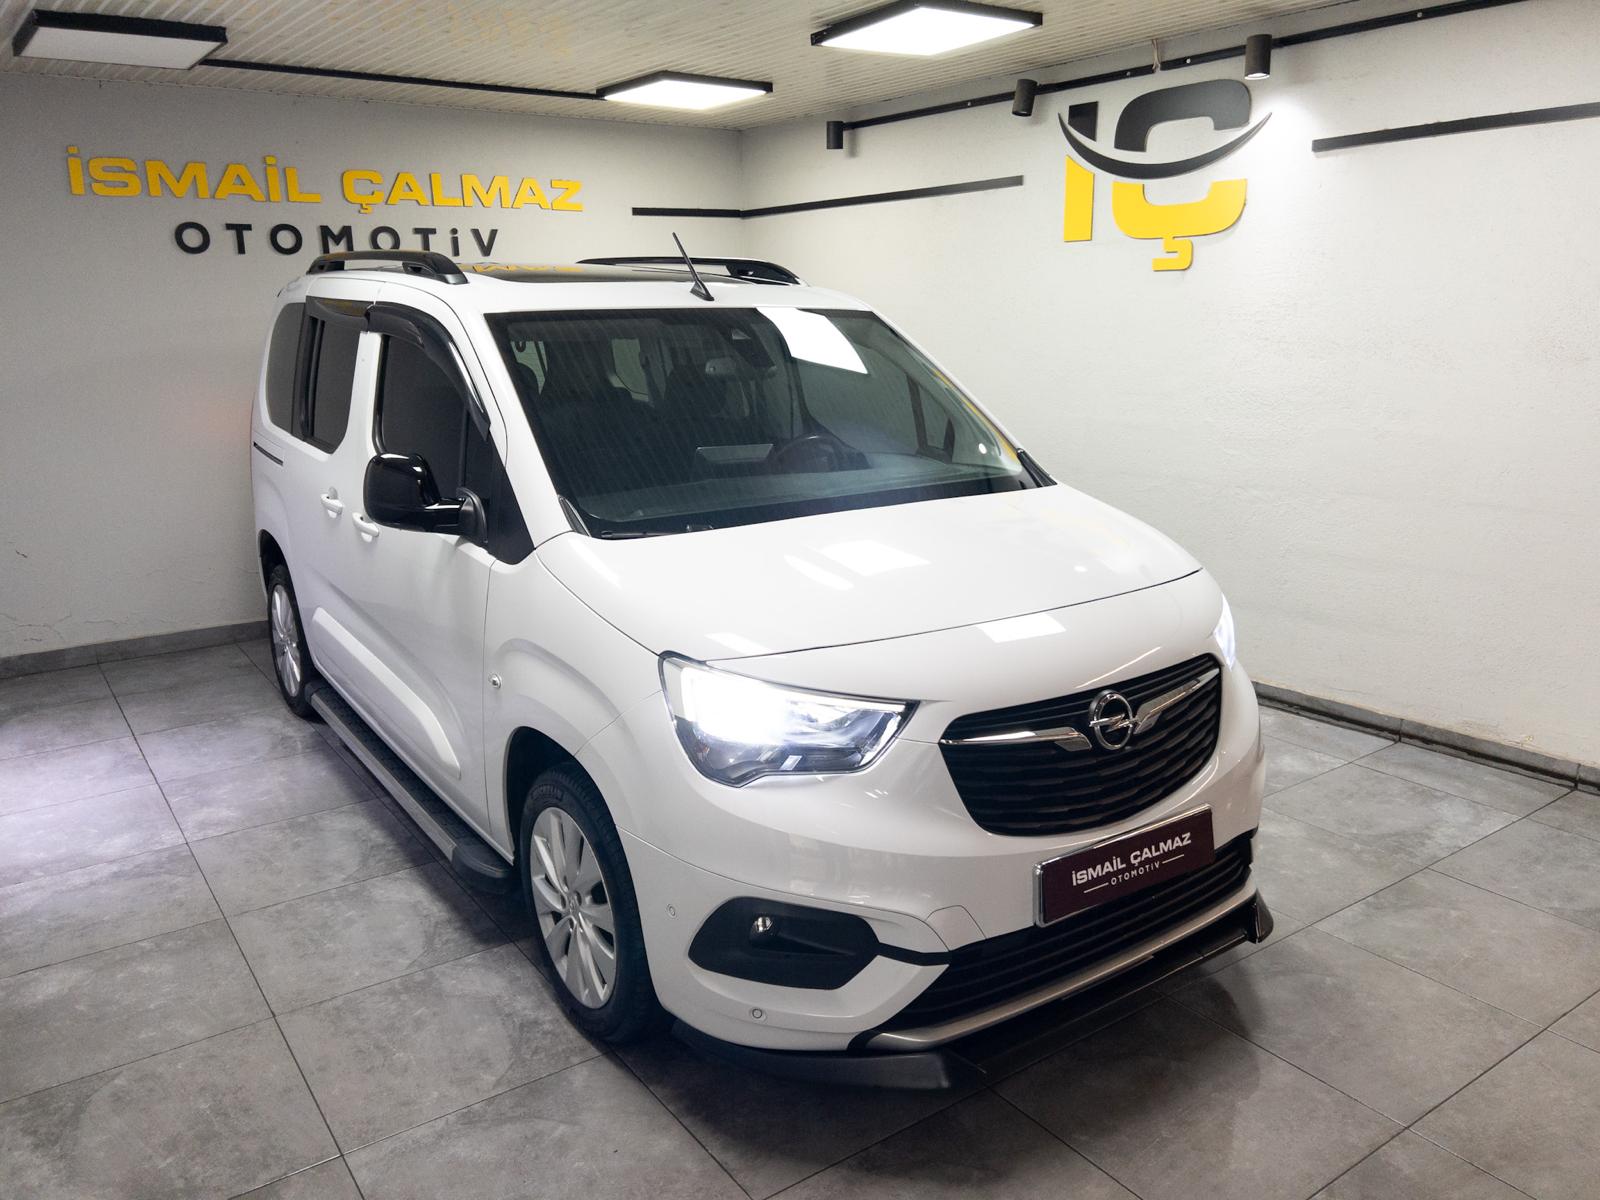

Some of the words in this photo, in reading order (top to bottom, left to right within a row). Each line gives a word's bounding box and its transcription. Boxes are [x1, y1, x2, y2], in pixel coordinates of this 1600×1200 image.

[67, 146, 321, 203] İSMAİL
[342, 169, 583, 214] ÇALMAZ
[1071, 856, 1126, 886] İSMAİL
[1130, 832, 1192, 866] ÇALMAZ
